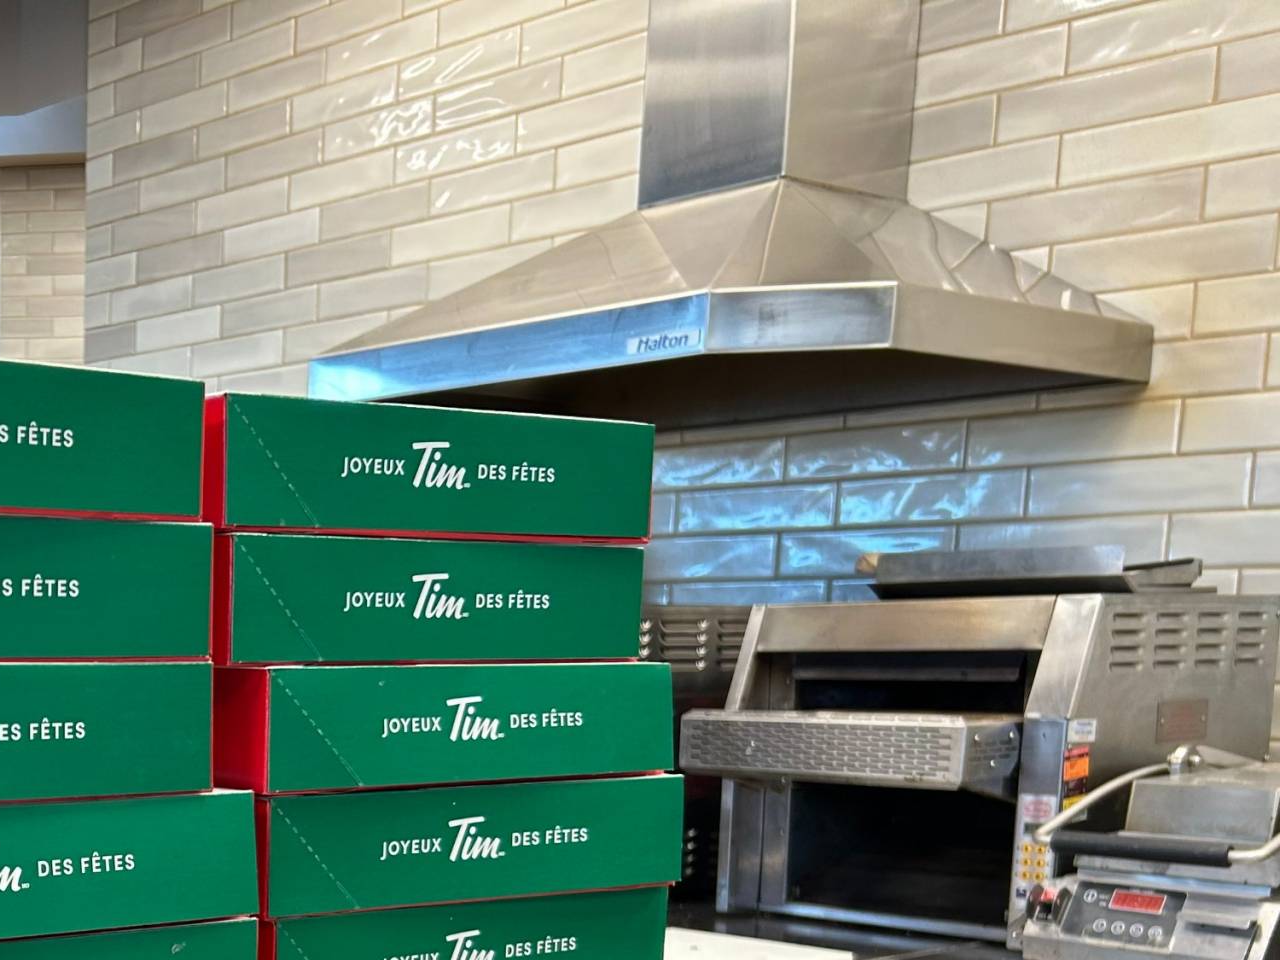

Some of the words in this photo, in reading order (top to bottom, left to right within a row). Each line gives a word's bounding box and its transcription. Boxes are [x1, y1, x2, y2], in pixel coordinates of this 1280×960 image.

[636, 333, 689, 353] Halton
[16, 420, 74, 448] FÊTES
[340, 456, 405, 478] JOYEUX
[412, 441, 471, 490] Tim
[477, 463, 507, 481] DES
[511, 461, 556, 483] FÊTES
[21, 573, 80, 598] FÊTES
[343, 591, 406, 612] JOYEUX
[411, 572, 469, 620] Tim
[475, 593, 504, 609] DES
[508, 589, 550, 609] FÊTES
[29, 717, 86, 741] FÊTES
[381, 716, 442, 738] JOYEUX
[446, 695, 505, 742] Tim
[509, 713, 538, 729] DES
[541, 708, 583, 728] FÊTES
[379, 837, 442, 861] JOYEUX
[448, 815, 506, 862] Tim
[511, 830, 541, 847] DES
[545, 825, 588, 845] FÊTES
[37, 858, 74, 877] DES
[80, 851, 135, 874] FÊTES
[505, 941, 532, 959] DES
[536, 935, 577, 955] FÊTES
